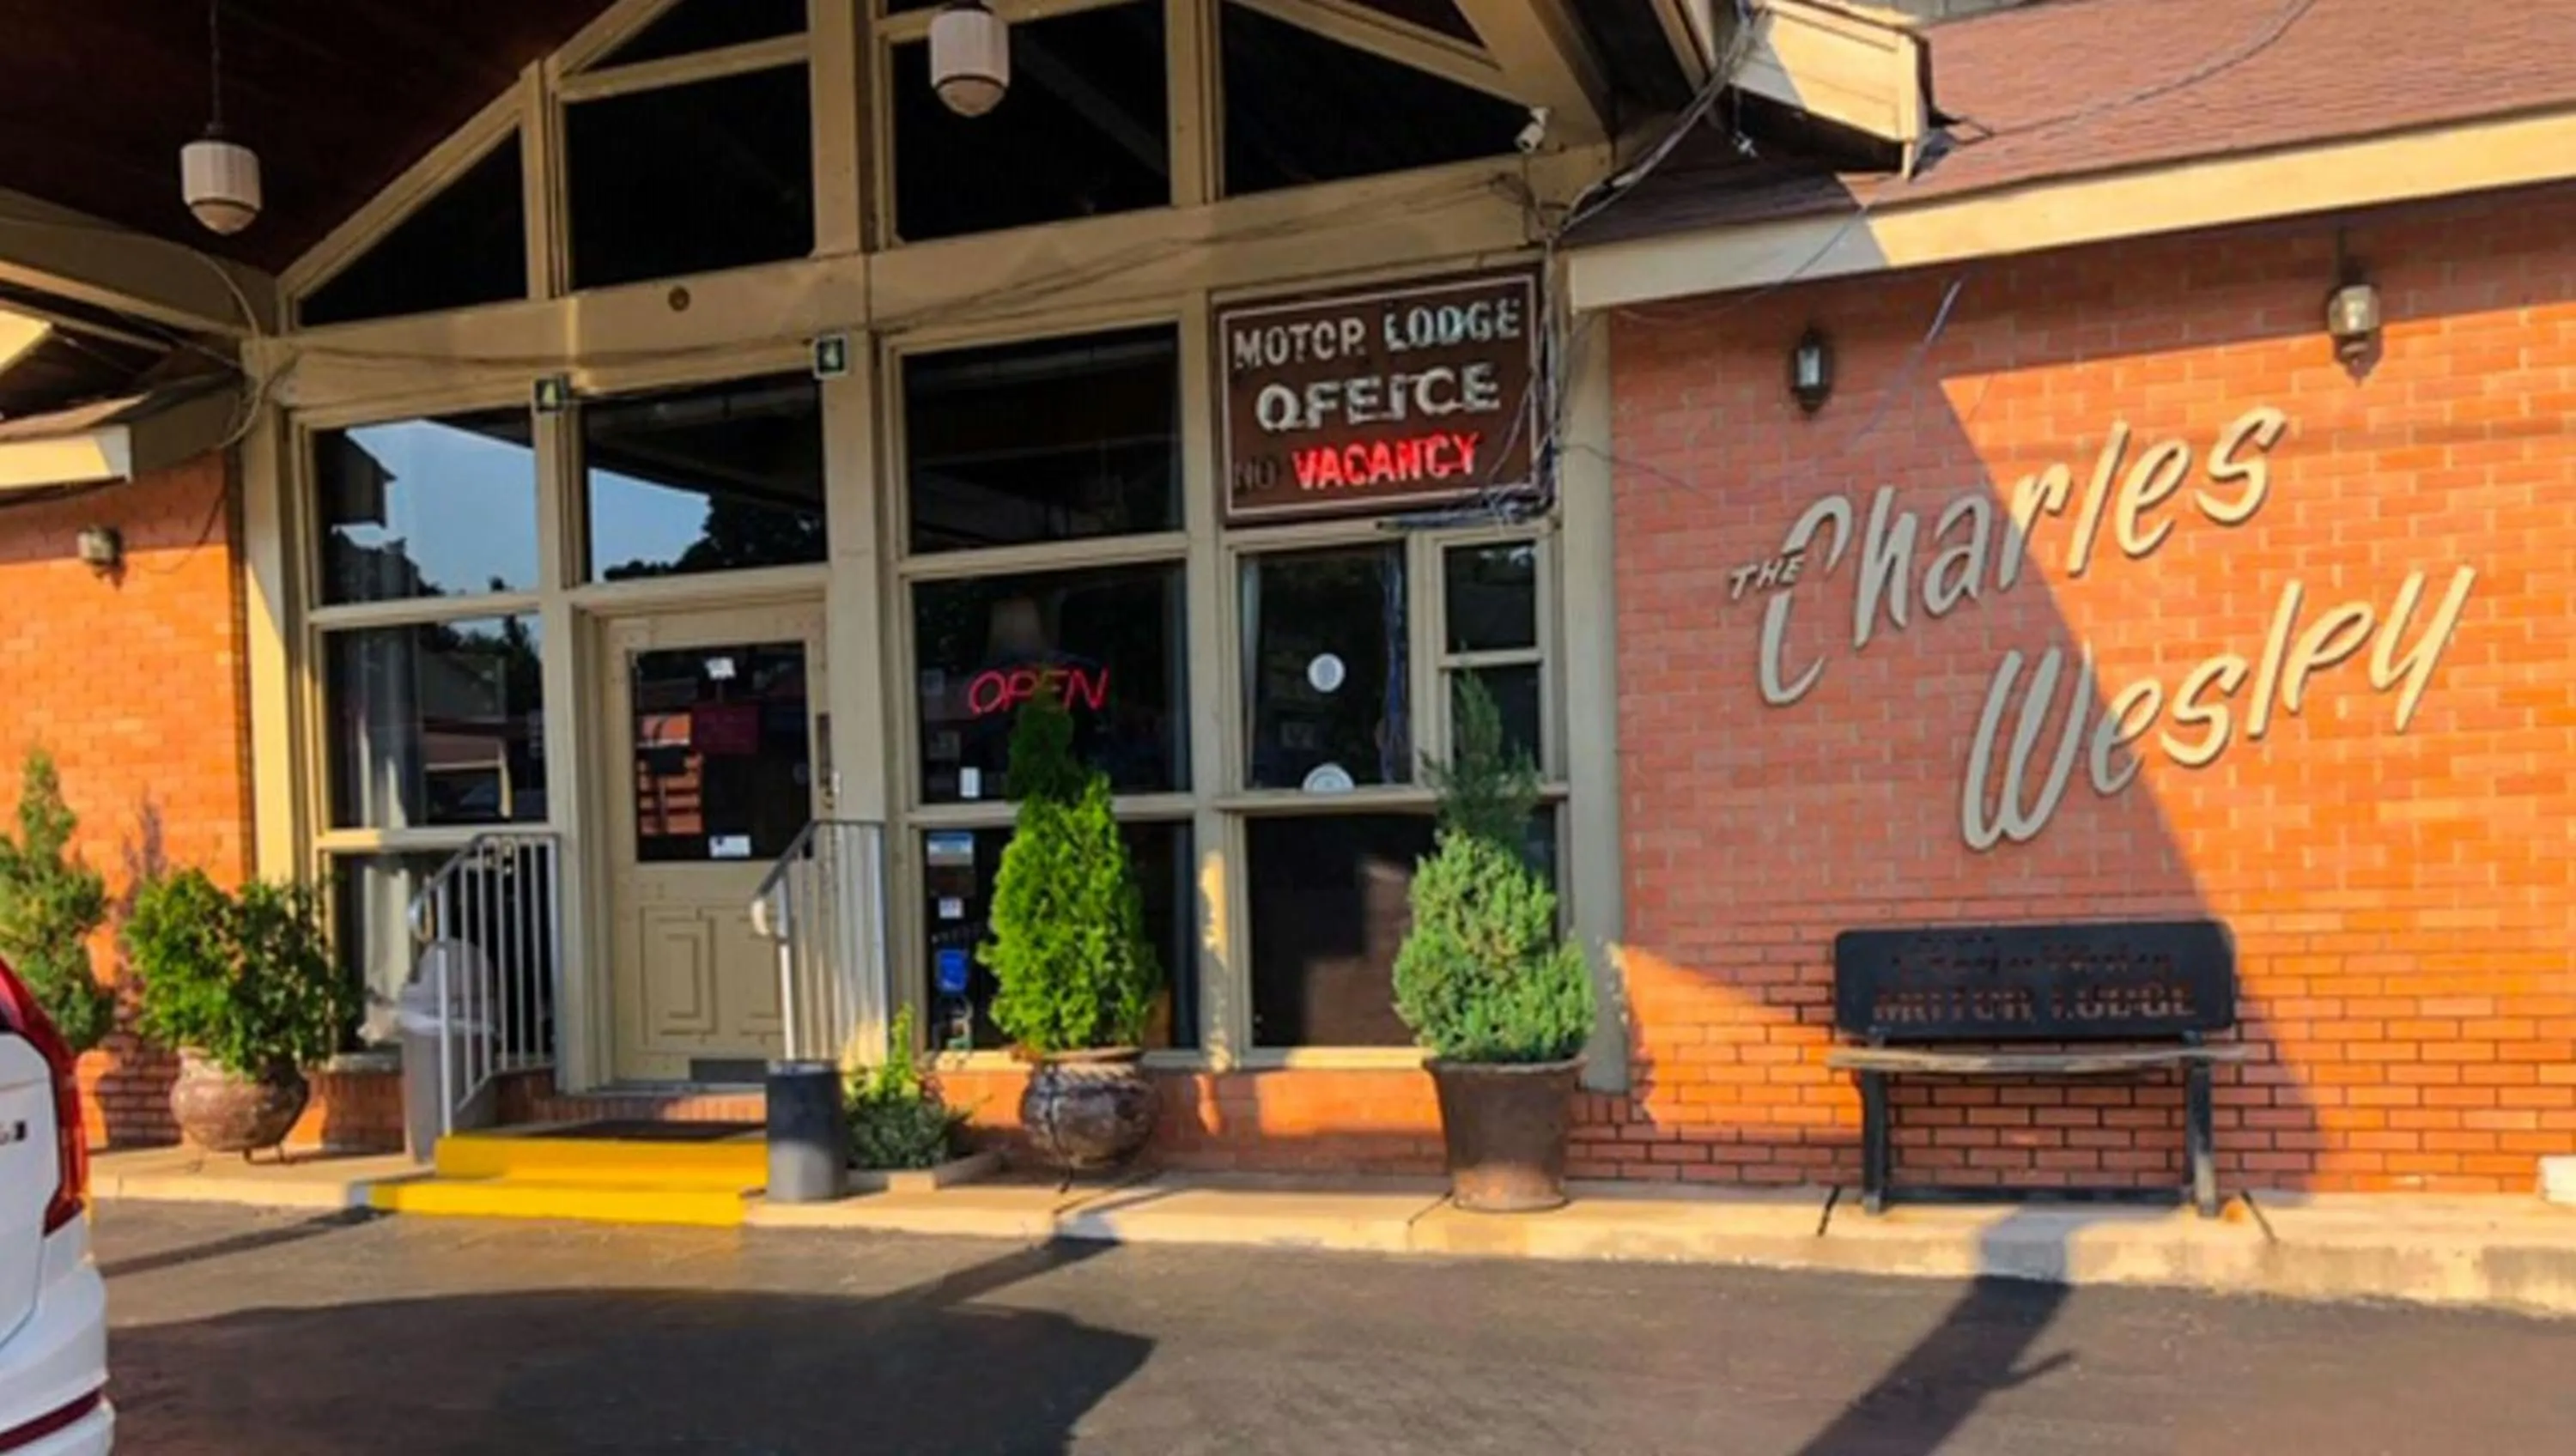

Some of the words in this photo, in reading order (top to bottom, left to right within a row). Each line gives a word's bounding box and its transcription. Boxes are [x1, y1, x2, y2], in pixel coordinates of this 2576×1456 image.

[1234, 317, 1366, 369] MOTOR
[1383, 297, 1521, 351] LODGE
[1255, 361, 1501, 431] OFFICE
[1234, 453, 1278, 492] NO
[1292, 432, 1479, 490] VACANCY
[1728, 554, 1806, 600] THE
[1759, 405, 2287, 706] Charles
[968, 664, 1110, 715] OPEN
[1961, 565, 2476, 850] Wesley
